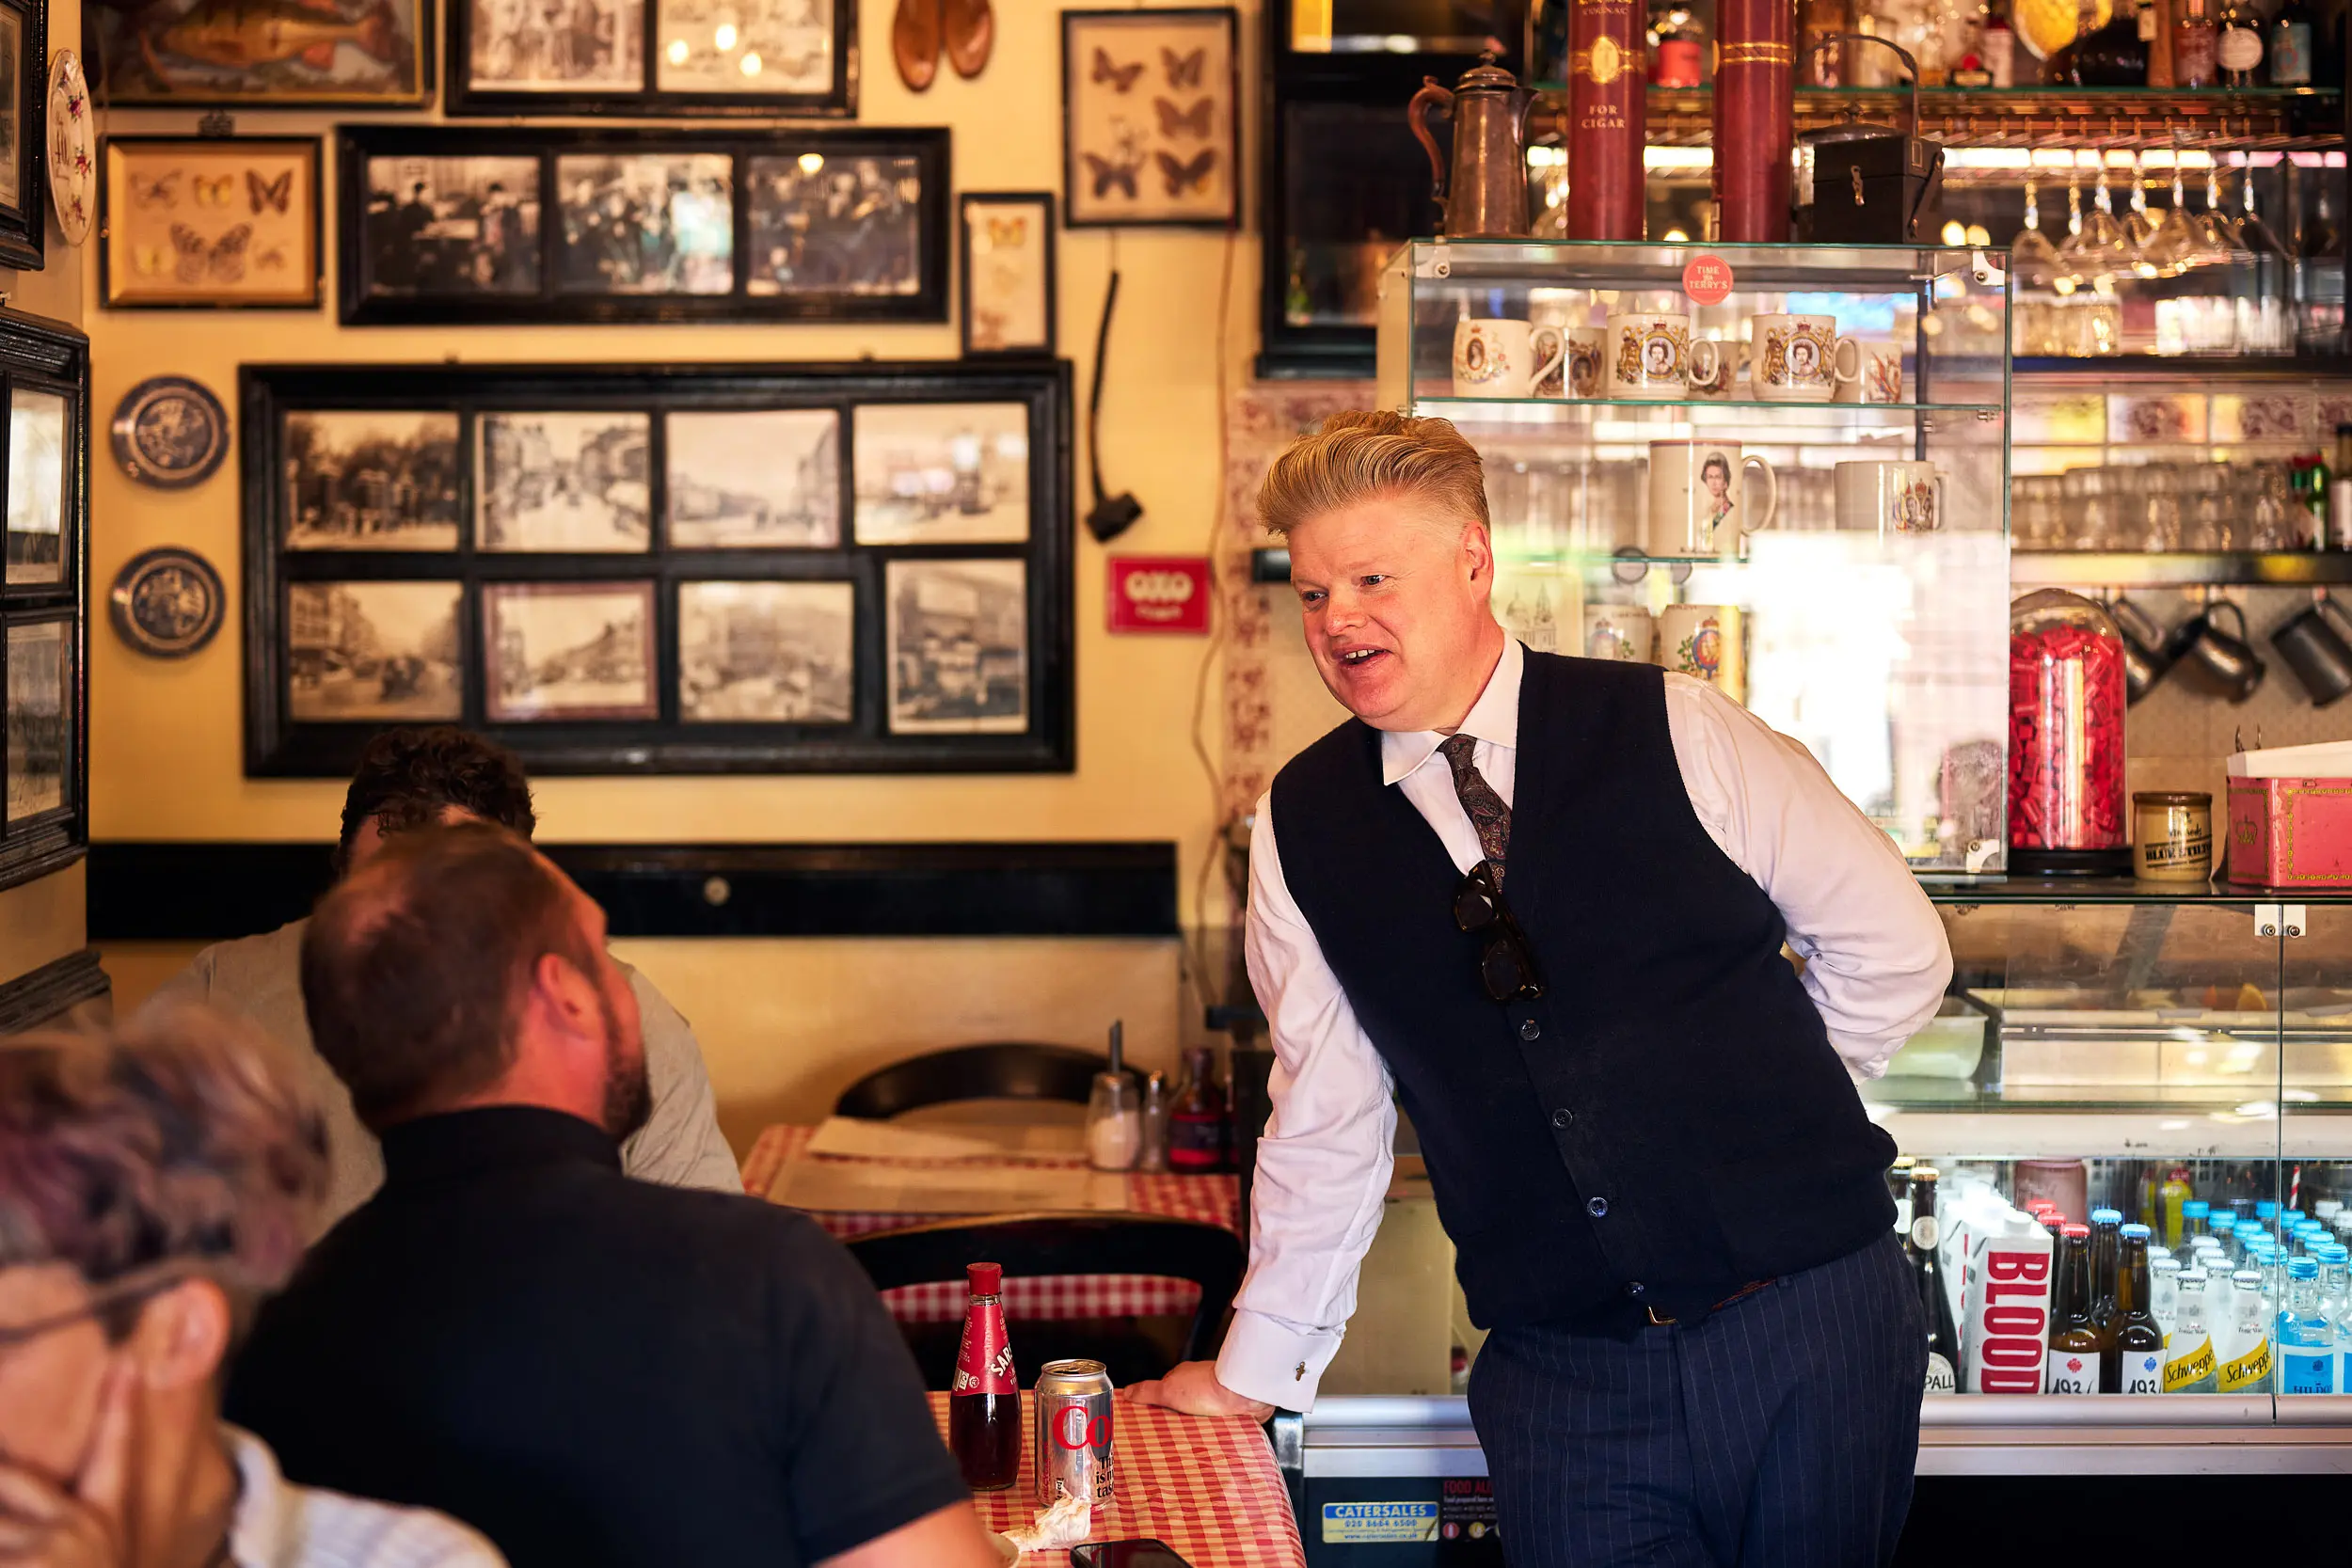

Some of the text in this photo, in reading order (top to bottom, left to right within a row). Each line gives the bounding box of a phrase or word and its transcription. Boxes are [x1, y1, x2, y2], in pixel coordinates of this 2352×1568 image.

[1590, 104, 1617, 115] FOR
[1581, 118, 1625, 129] CIGAR
[1697, 265, 1720, 275] TIME
[1689, 280, 1728, 290] TERRY'S
[1980, 1251, 2050, 1394] BLOOD
[2167, 1348, 2214, 1385] Schweppe
[1924, 1374, 1954, 1390] PALL
[1053, 1401, 1114, 1449] Co
[1096, 1471, 1105, 1484] is
[1443, 1481, 1471, 1495] FOOD
[1335, 1505, 1427, 1517] CATERSALES
